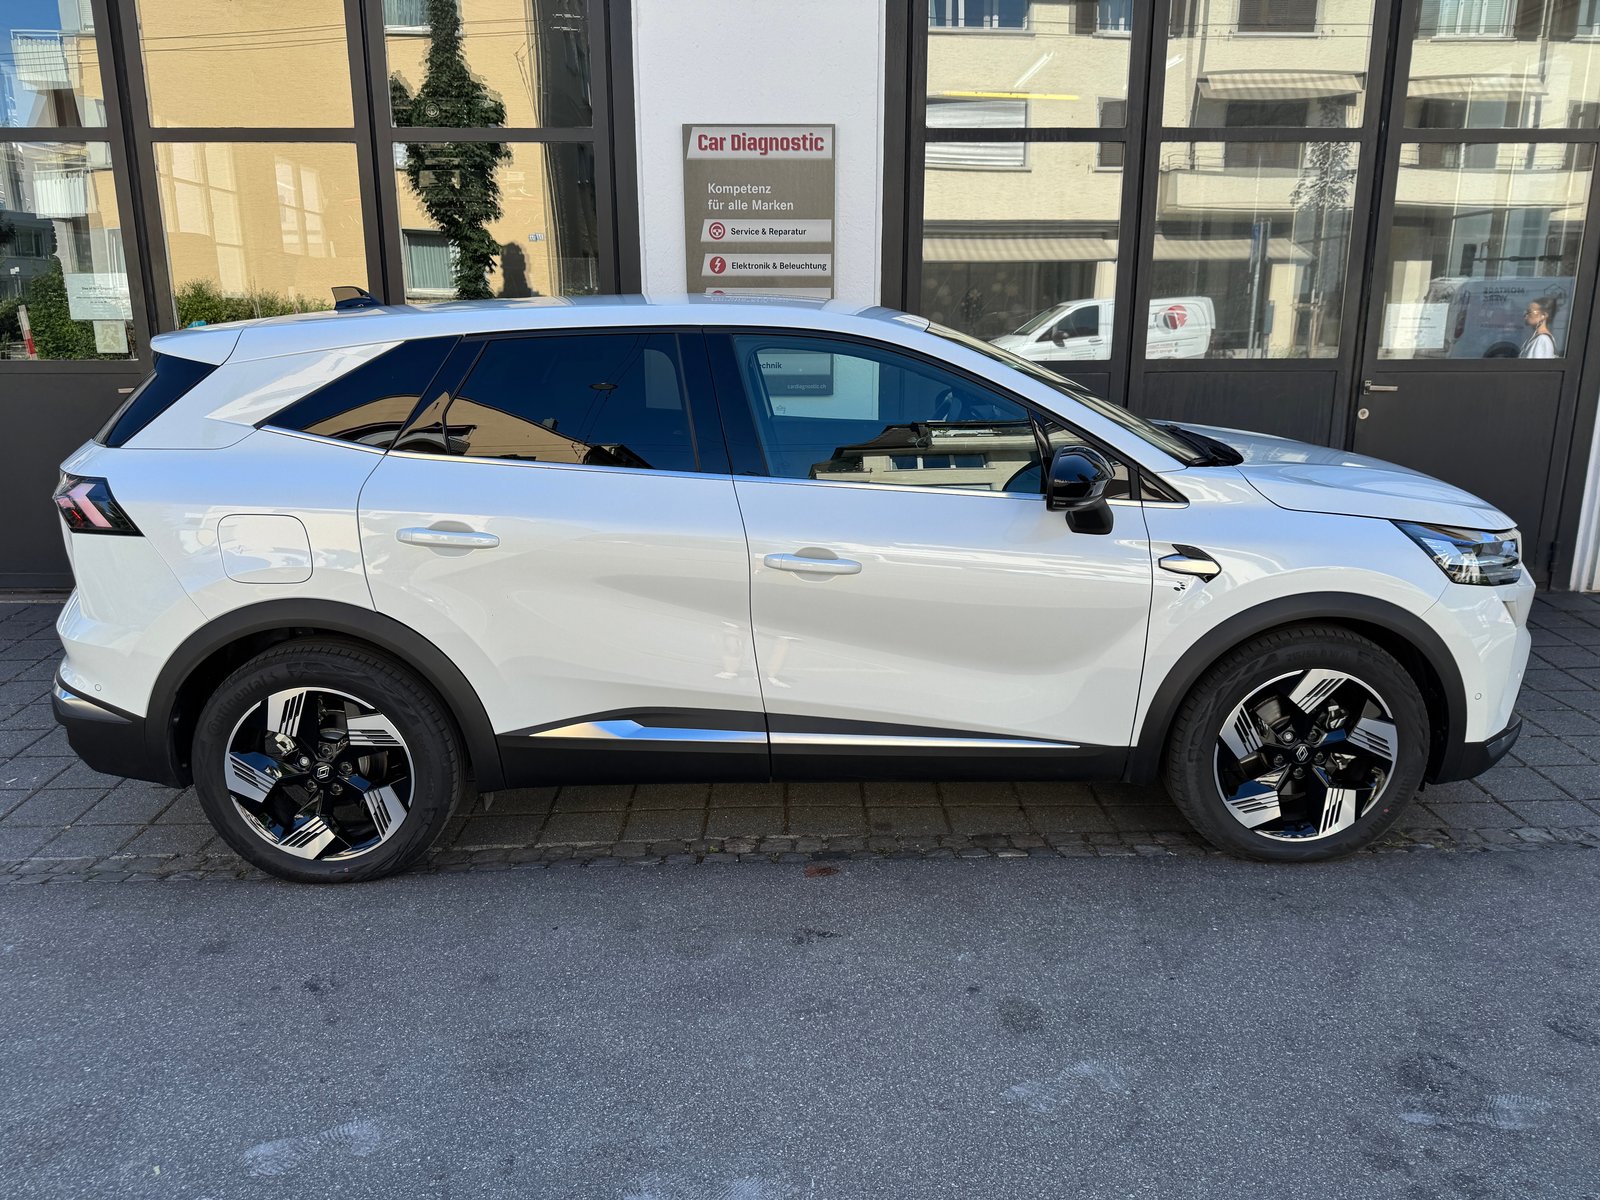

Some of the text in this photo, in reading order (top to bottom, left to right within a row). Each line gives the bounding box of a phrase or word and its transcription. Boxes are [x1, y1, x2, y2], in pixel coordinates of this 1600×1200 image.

[697, 133, 824, 155] Car Diagnostic
[707, 183, 772, 196] Kompetenz
[707, 199, 794, 211] für alle Marken
[730, 227, 807, 237] Service & Reparatur
[731, 261, 827, 271] Elektronik & Beleuchtung
